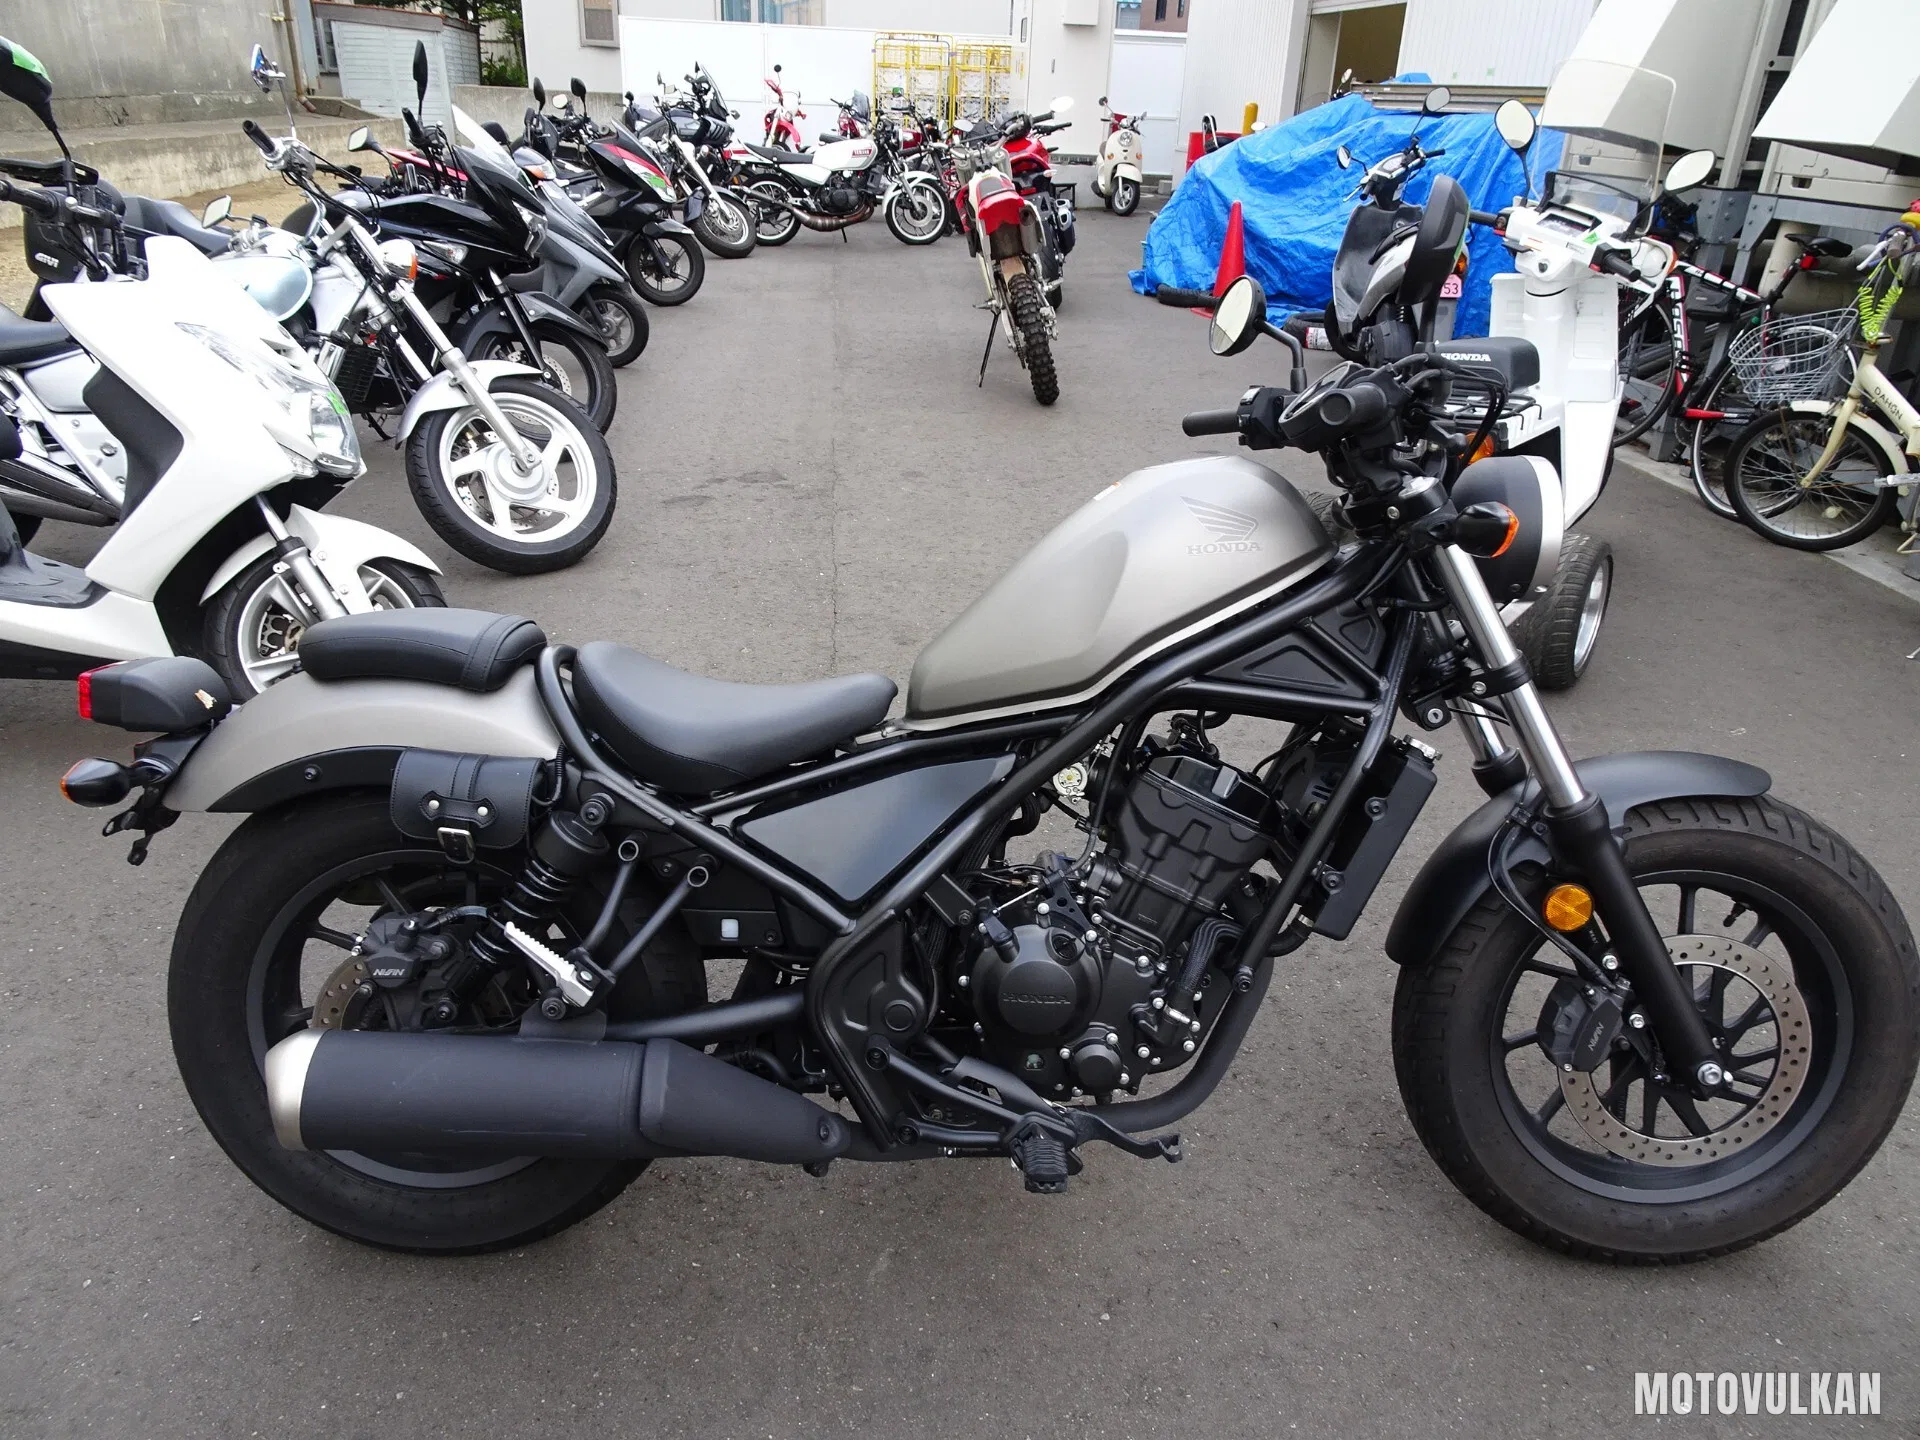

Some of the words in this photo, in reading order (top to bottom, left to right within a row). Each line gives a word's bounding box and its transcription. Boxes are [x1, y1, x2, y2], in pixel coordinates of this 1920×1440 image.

[1874, 386, 1903, 420] DAHON
[1185, 541, 1263, 555] HONDA
[1002, 992, 1071, 1004] HONDA
